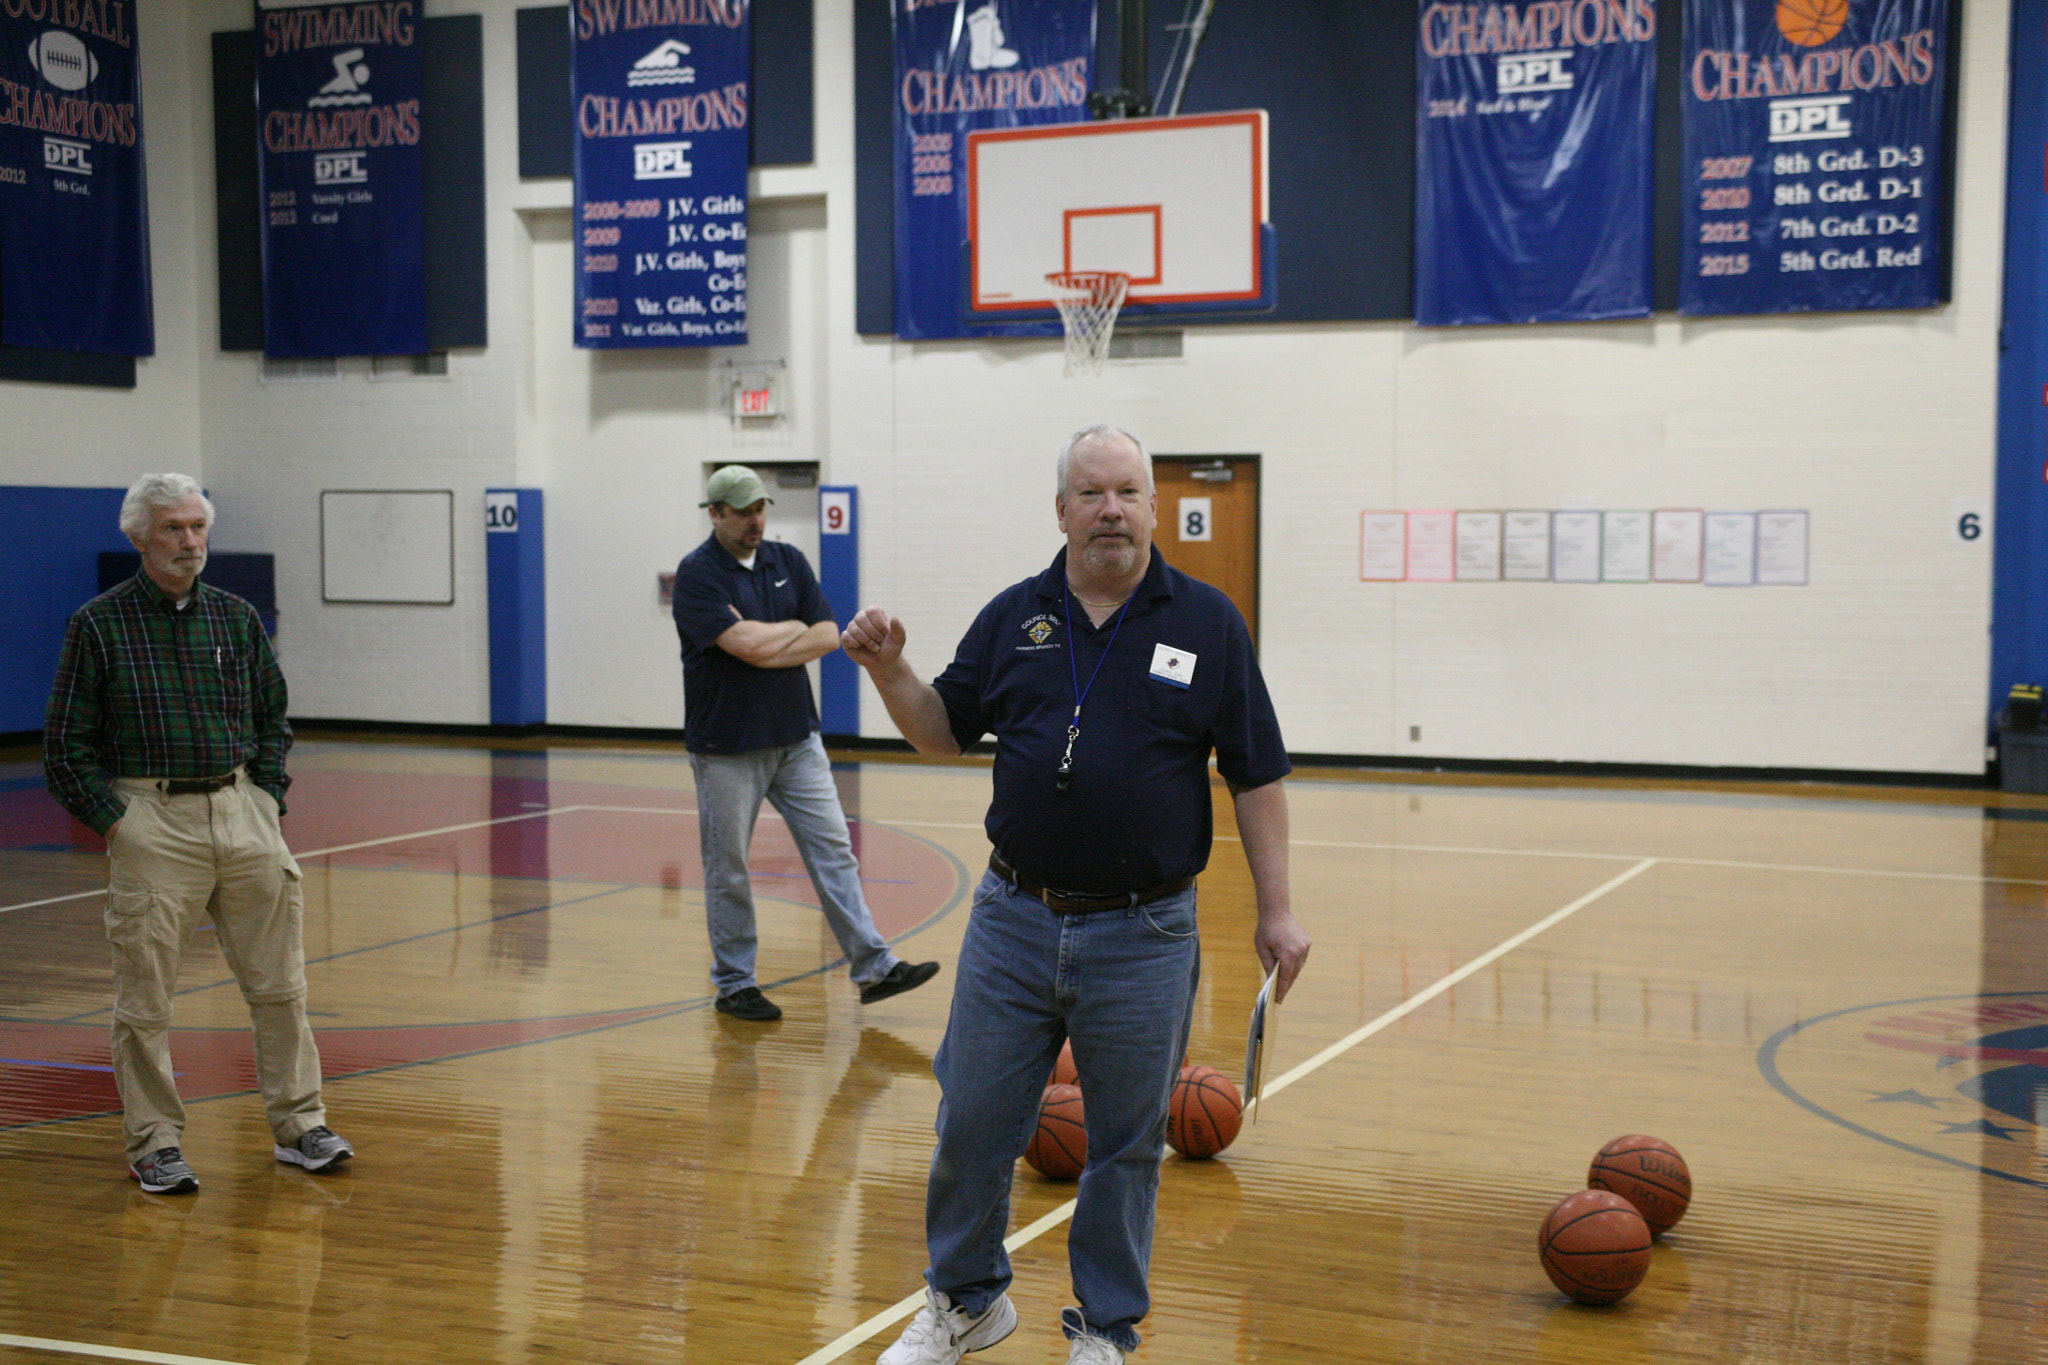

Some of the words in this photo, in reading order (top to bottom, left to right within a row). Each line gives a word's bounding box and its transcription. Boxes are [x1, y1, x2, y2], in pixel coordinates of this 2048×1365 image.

[264, 1, 416, 57] SWIMMING
[578, 0, 746, 41] SWIMMING
[1422, 0, 1656, 58] CHAMPIONS
[1497, 58, 1574, 86] DPL
[1692, 30, 1934, 101] CHAMPIONS
[902, 56, 1088, 115] CHAMPIONS
[579, 82, 748, 138] CHAMPIONS
[1770, 105, 1850, 135] DPL
[265, 99, 421, 153] CHAMPIONS
[44, 141, 92, 170] DPL
[315, 158, 368, 180] DPL
[634, 149, 693, 173] DPL
[1701, 157, 1753, 180] 2007
[1773, 153, 1811, 175] 8th
[1817, 149, 1869, 172] Grd.
[1878, 145, 1925, 168] D-3
[54, 179, 69, 193] 5th
[70, 182, 91, 196] Grd.
[1773, 183, 1811, 206] 8th
[1817, 179, 1870, 203] Grd.
[1878, 177, 1923, 200] D-1
[667, 197, 698, 221] J.V.
[702, 194, 745, 215] Girls
[667, 224, 699, 247] J.V.
[1700, 221, 1750, 243] 2012
[1779, 217, 1815, 239] 7th
[1819, 215, 1872, 237] Grd.
[1876, 212, 1920, 235] D-2
[635, 252, 664, 276] J.V.
[1699, 253, 1750, 277] 2015
[1779, 251, 1816, 273] 5th
[1819, 248, 1872, 271] Grd.
[1876, 245, 1923, 268] Red
[742, 389, 769, 413] EXIT
[487, 504, 518, 528] 10
[828, 505, 843, 530] 9
[1186, 511, 1204, 536] 8
[1958, 512, 1982, 541] 6
